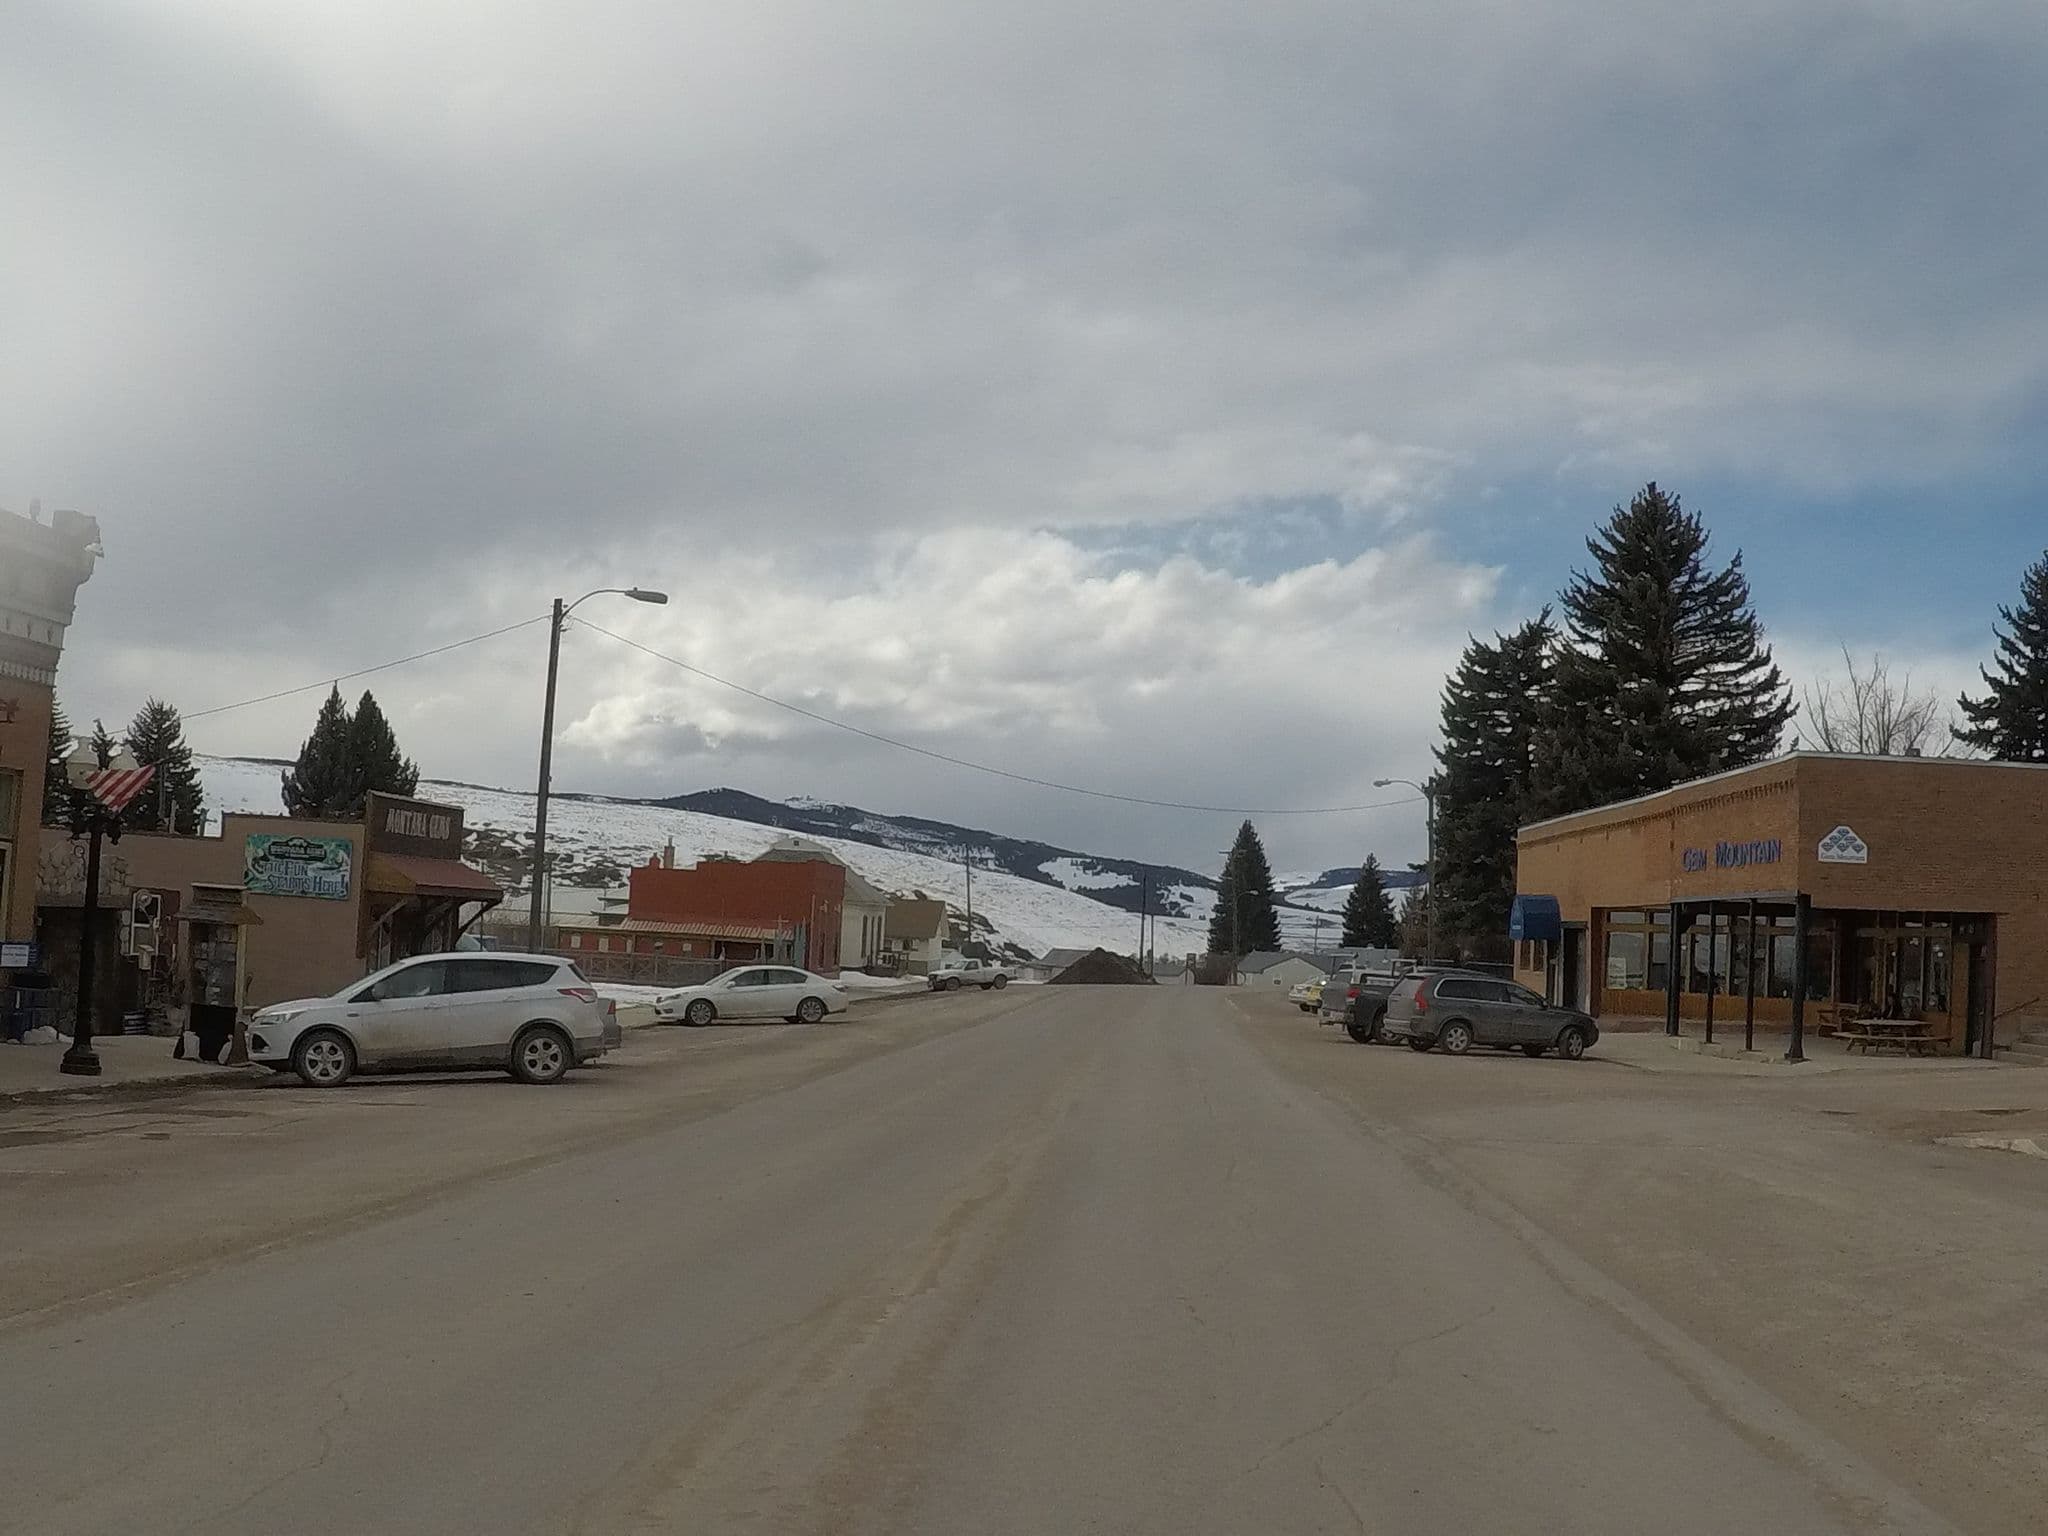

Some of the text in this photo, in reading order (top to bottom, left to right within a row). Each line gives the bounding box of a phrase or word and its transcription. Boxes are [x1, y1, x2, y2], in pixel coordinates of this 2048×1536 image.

[1715, 839, 1782, 869] MOUNTAIN
[284, 861, 309, 876] FUN
[267, 874, 347, 895] STARTS HERE!
